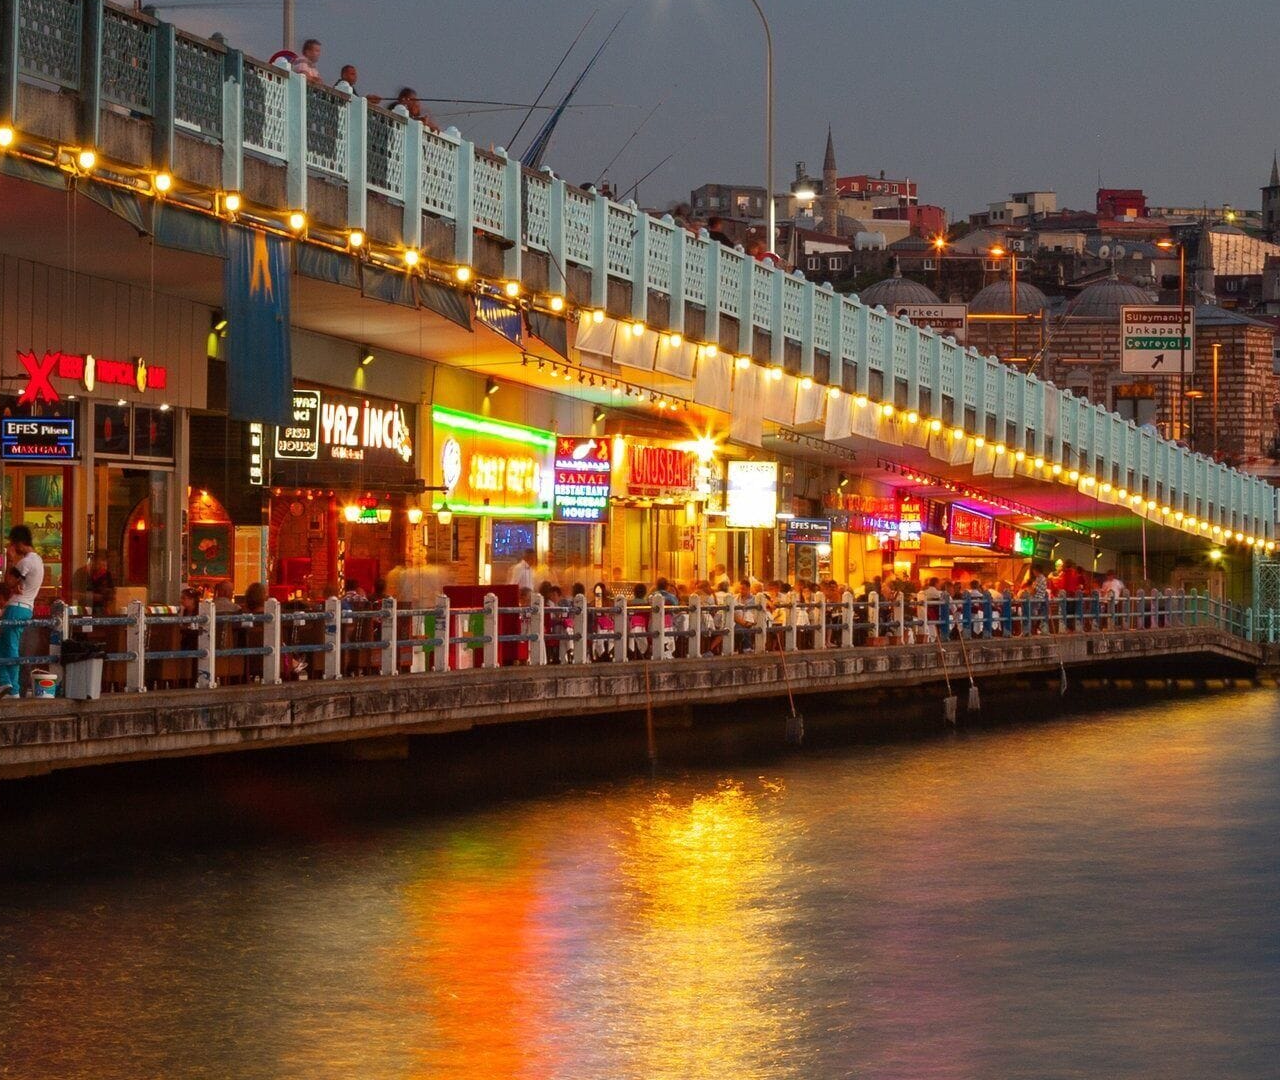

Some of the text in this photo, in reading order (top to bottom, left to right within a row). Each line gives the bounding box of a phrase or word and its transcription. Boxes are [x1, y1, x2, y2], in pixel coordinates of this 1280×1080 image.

[908, 308, 944, 318] irkeci
[8, 423, 69, 436] EFES Pilsen
[558, 472, 607, 485] SANAT
[562, 507, 600, 519] HOUSE
